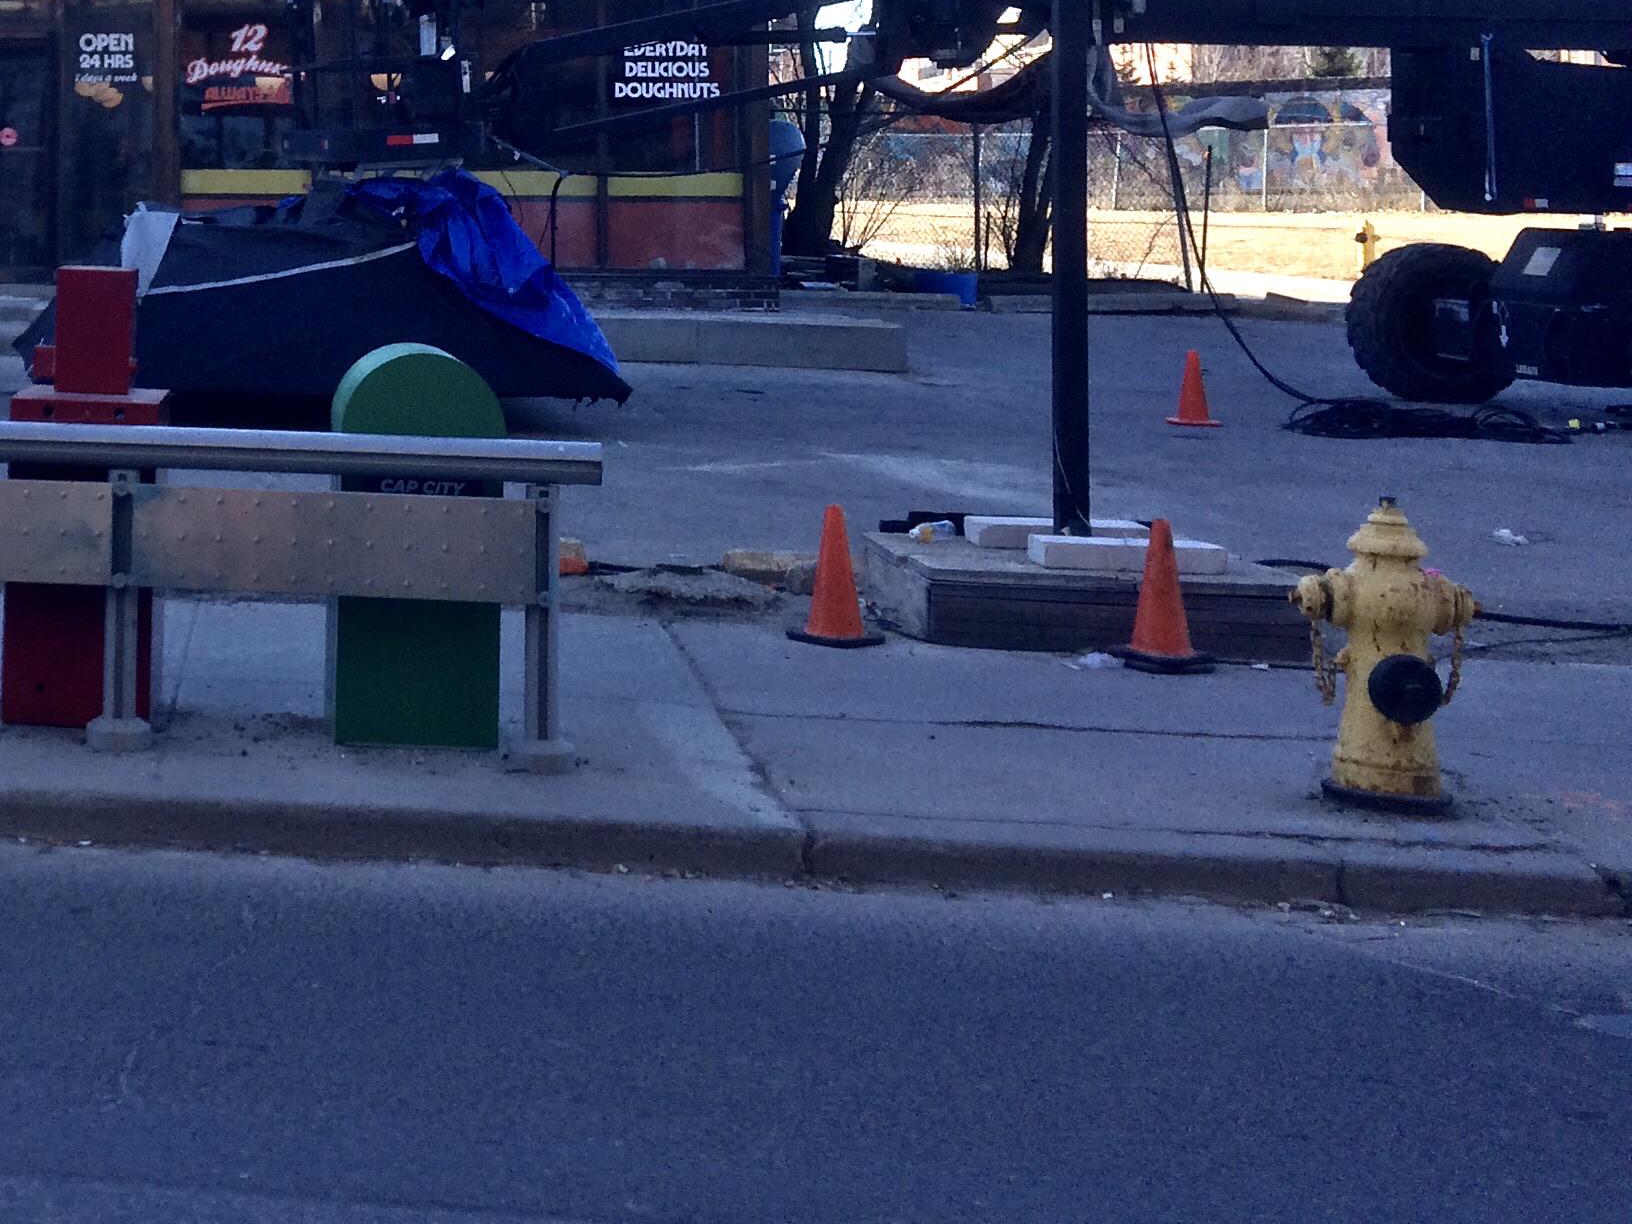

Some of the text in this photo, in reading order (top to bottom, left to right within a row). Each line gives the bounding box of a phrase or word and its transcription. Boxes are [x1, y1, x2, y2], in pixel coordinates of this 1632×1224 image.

[78, 32, 134, 52] OPEN
[231, 23, 268, 52] 12
[79, 53, 134, 69] 24 HRS
[625, 61, 710, 77] DELICIOUS
[614, 81, 721, 98] DOUGHNUTS
[380, 478, 467, 496] CAP CITY
